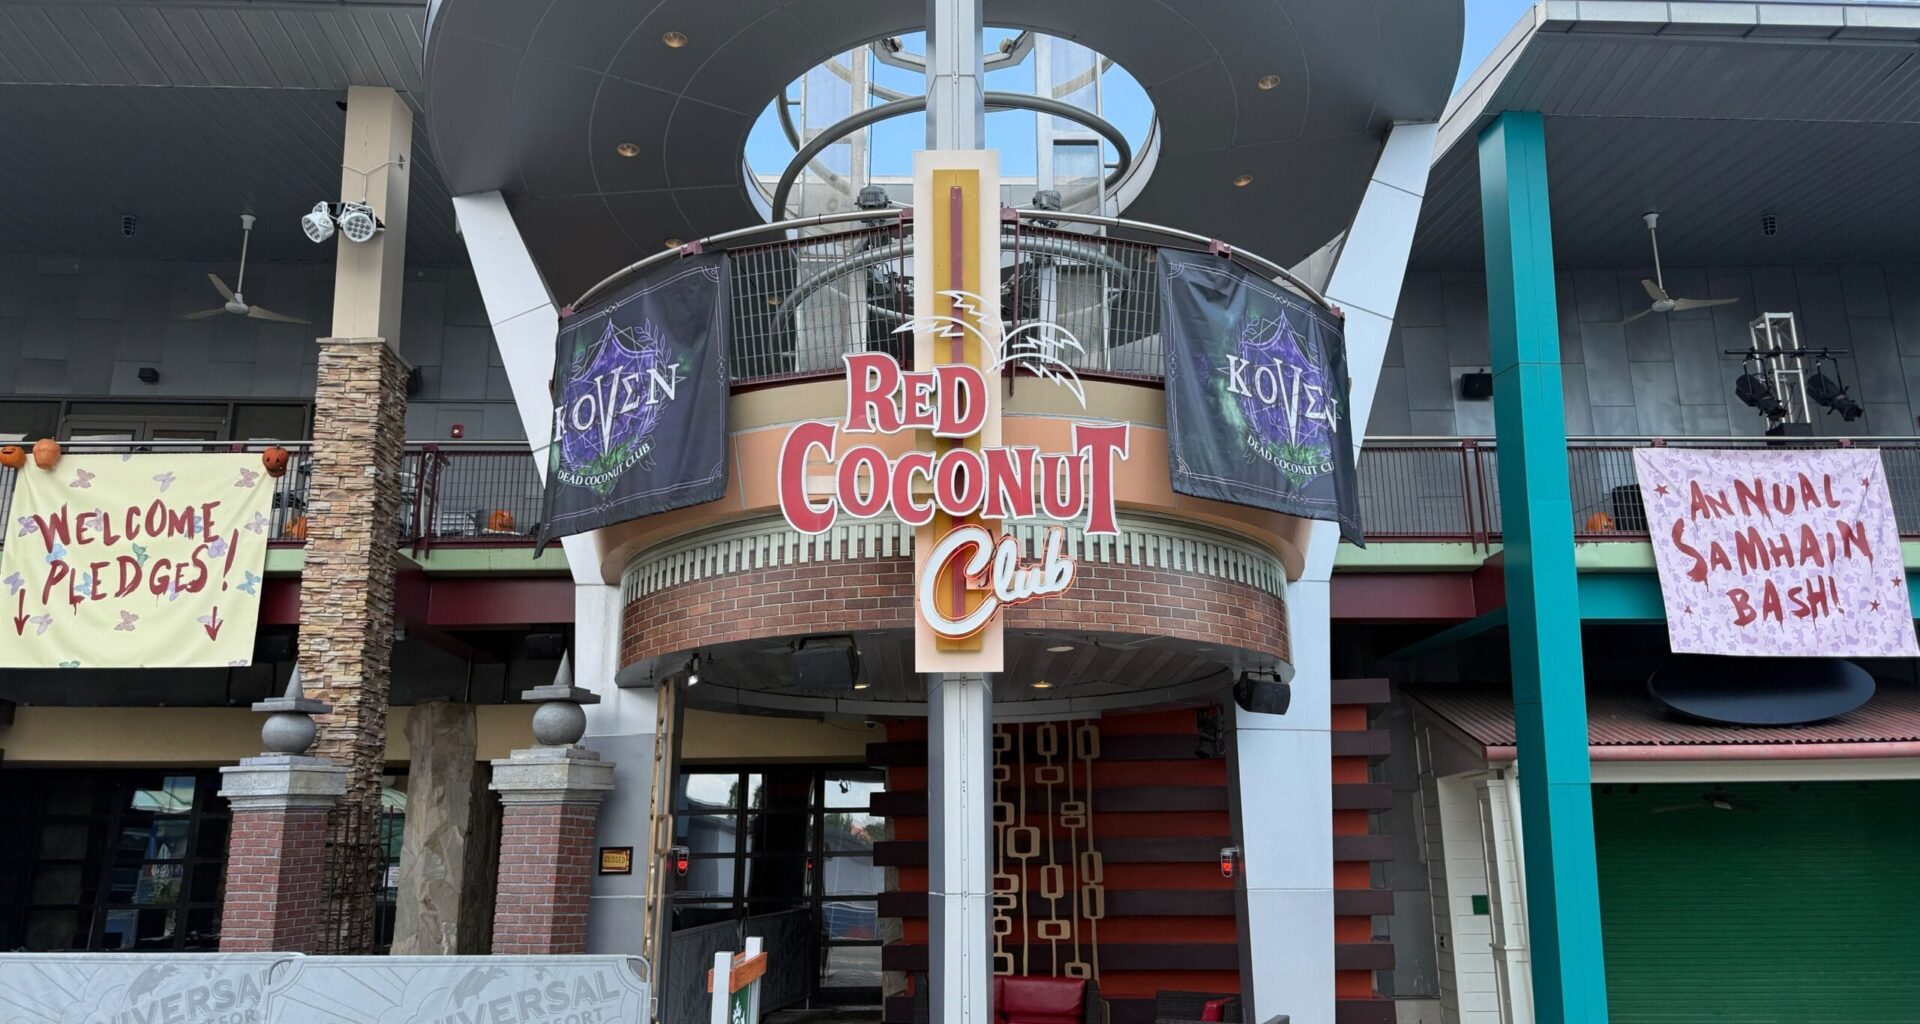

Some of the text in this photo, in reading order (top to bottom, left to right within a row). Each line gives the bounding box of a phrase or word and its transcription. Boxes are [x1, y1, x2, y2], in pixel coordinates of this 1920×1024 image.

[553, 363, 680, 457] KOVEN
[842, 351, 989, 438] RED
[1226, 354, 1338, 448] KOVEN
[557, 442, 650, 486] DEAD COCONUT CLUB
[778, 421, 1130, 536] COCONUT
[1247, 435, 1272, 461] DEAD
[1273, 457, 1317, 475] COCONUT
[34, 499, 221, 553] WELCOME
[1690, 472, 1840, 524] ANNUAL
[42, 528, 239, 610] PLEDGES!
[917, 523, 1077, 640] Club
[1672, 518, 1873, 585] SAMHAIN
[1726, 575, 1844, 629] BASH!
